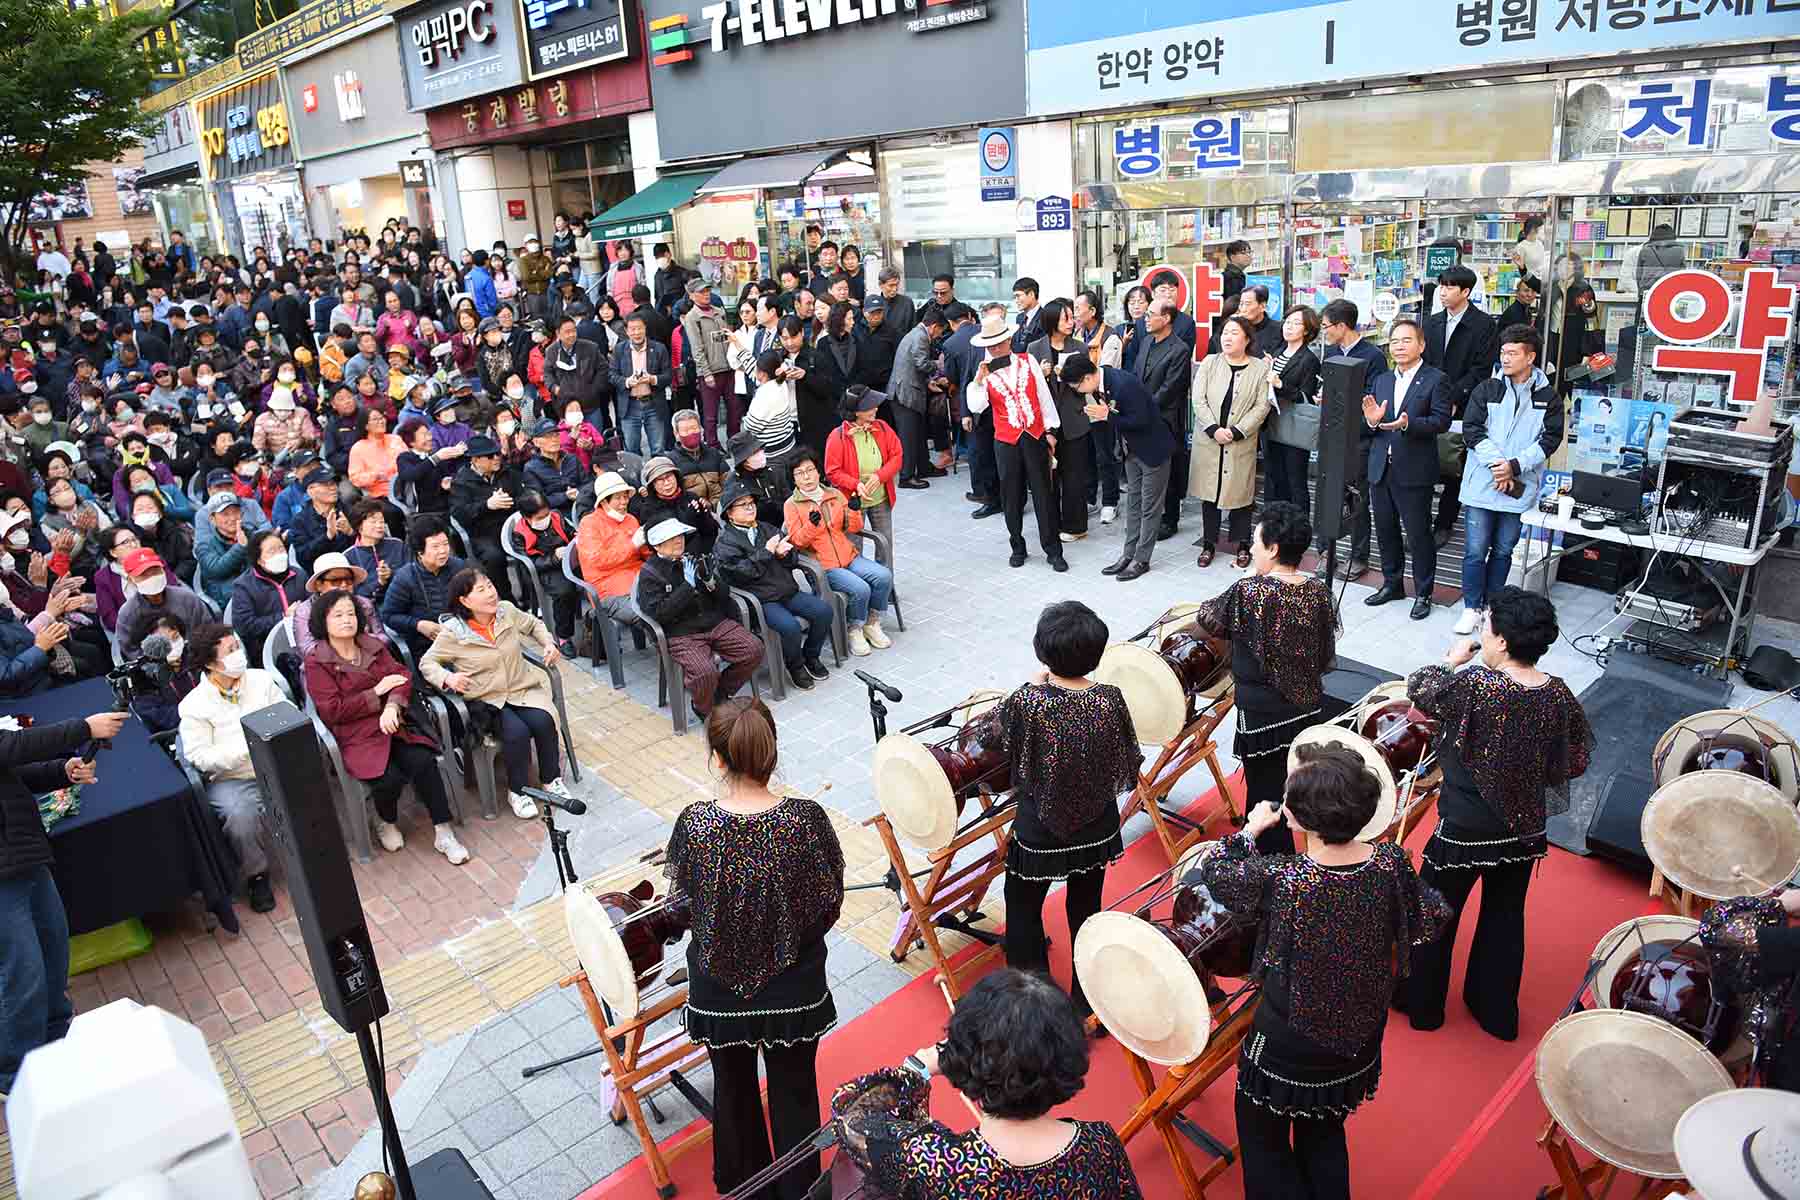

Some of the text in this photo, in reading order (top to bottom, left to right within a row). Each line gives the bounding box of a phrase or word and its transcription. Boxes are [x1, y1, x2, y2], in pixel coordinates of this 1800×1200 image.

[411, 0, 490, 66] 엠픽PC
[1456, 0, 1537, 46] 병원
[1097, 37, 1224, 89] 한약 양약
[986, 143, 1008, 159] 담배
[1042, 213, 1065, 228] 893
[1647, 270, 1791, 402] 약
